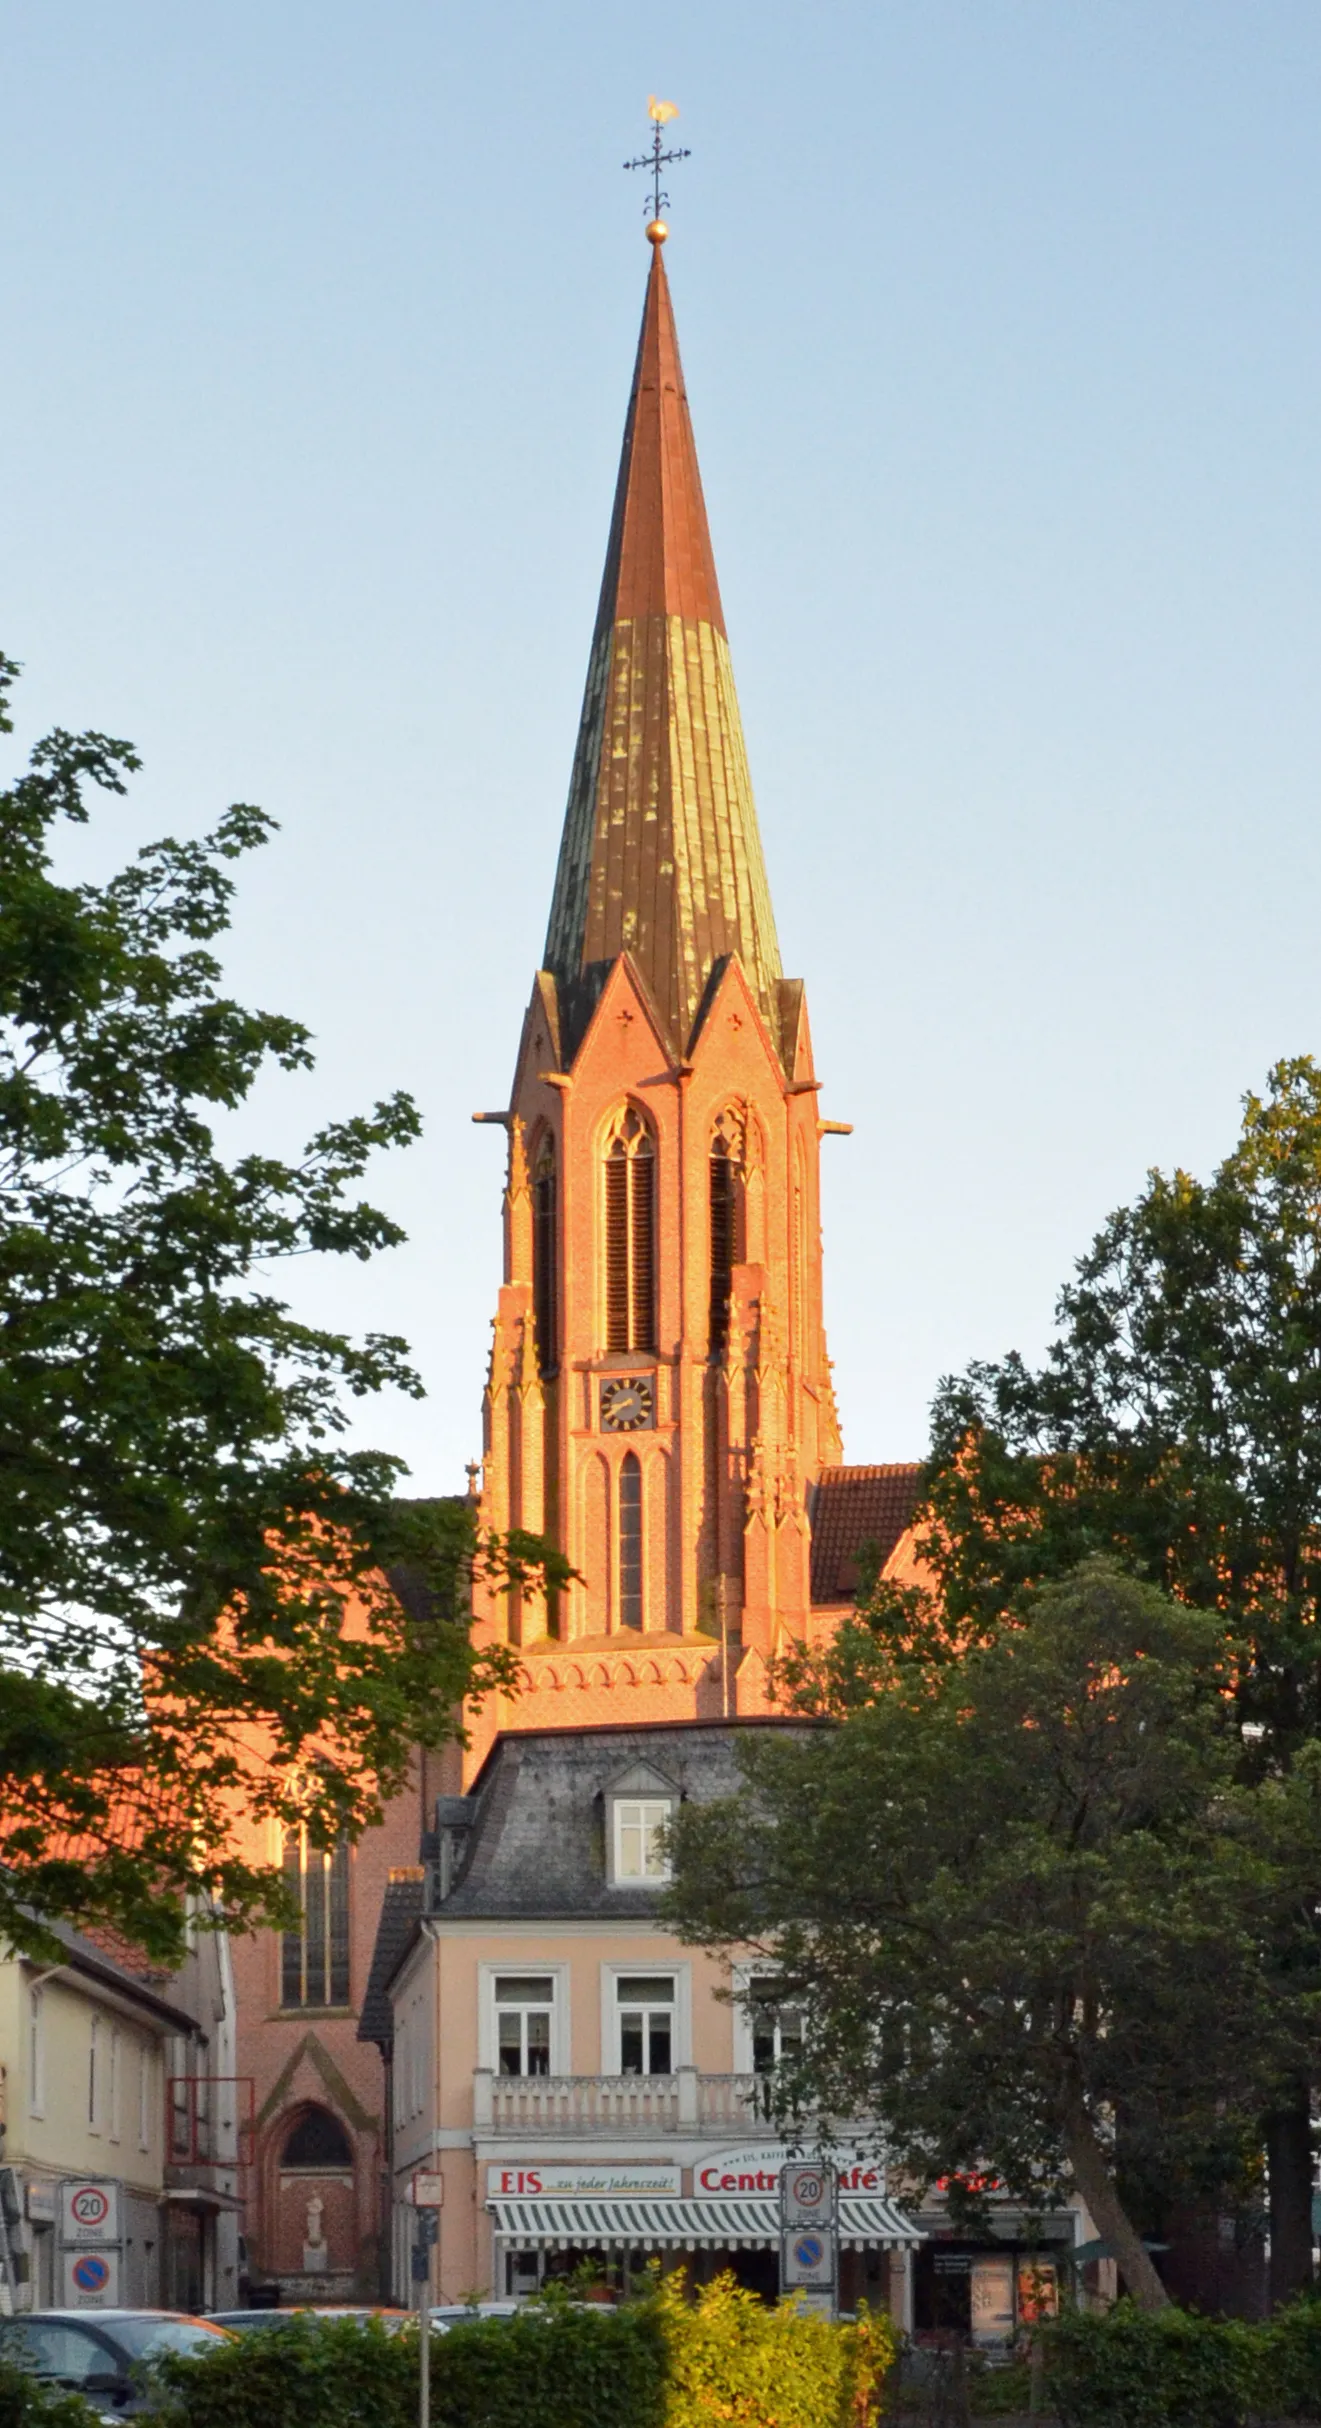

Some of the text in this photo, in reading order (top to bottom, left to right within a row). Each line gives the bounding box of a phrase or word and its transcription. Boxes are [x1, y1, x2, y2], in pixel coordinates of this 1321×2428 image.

[501, 2171, 543, 2194] EIS
[574, 2176, 607, 2195] jeder
[607, 2175, 674, 2192] Jahreszeit!
[700, 2166, 878, 2191] Centr afé
[800, 2181, 818, 2198] 20
[80, 2198, 100, 2216] 20
[797, 2209, 821, 2218] ZONE
[76, 2227, 104, 2237] ZONE
[797, 2271, 821, 2281] ZONE
[77, 2295, 104, 2304] ZONE
